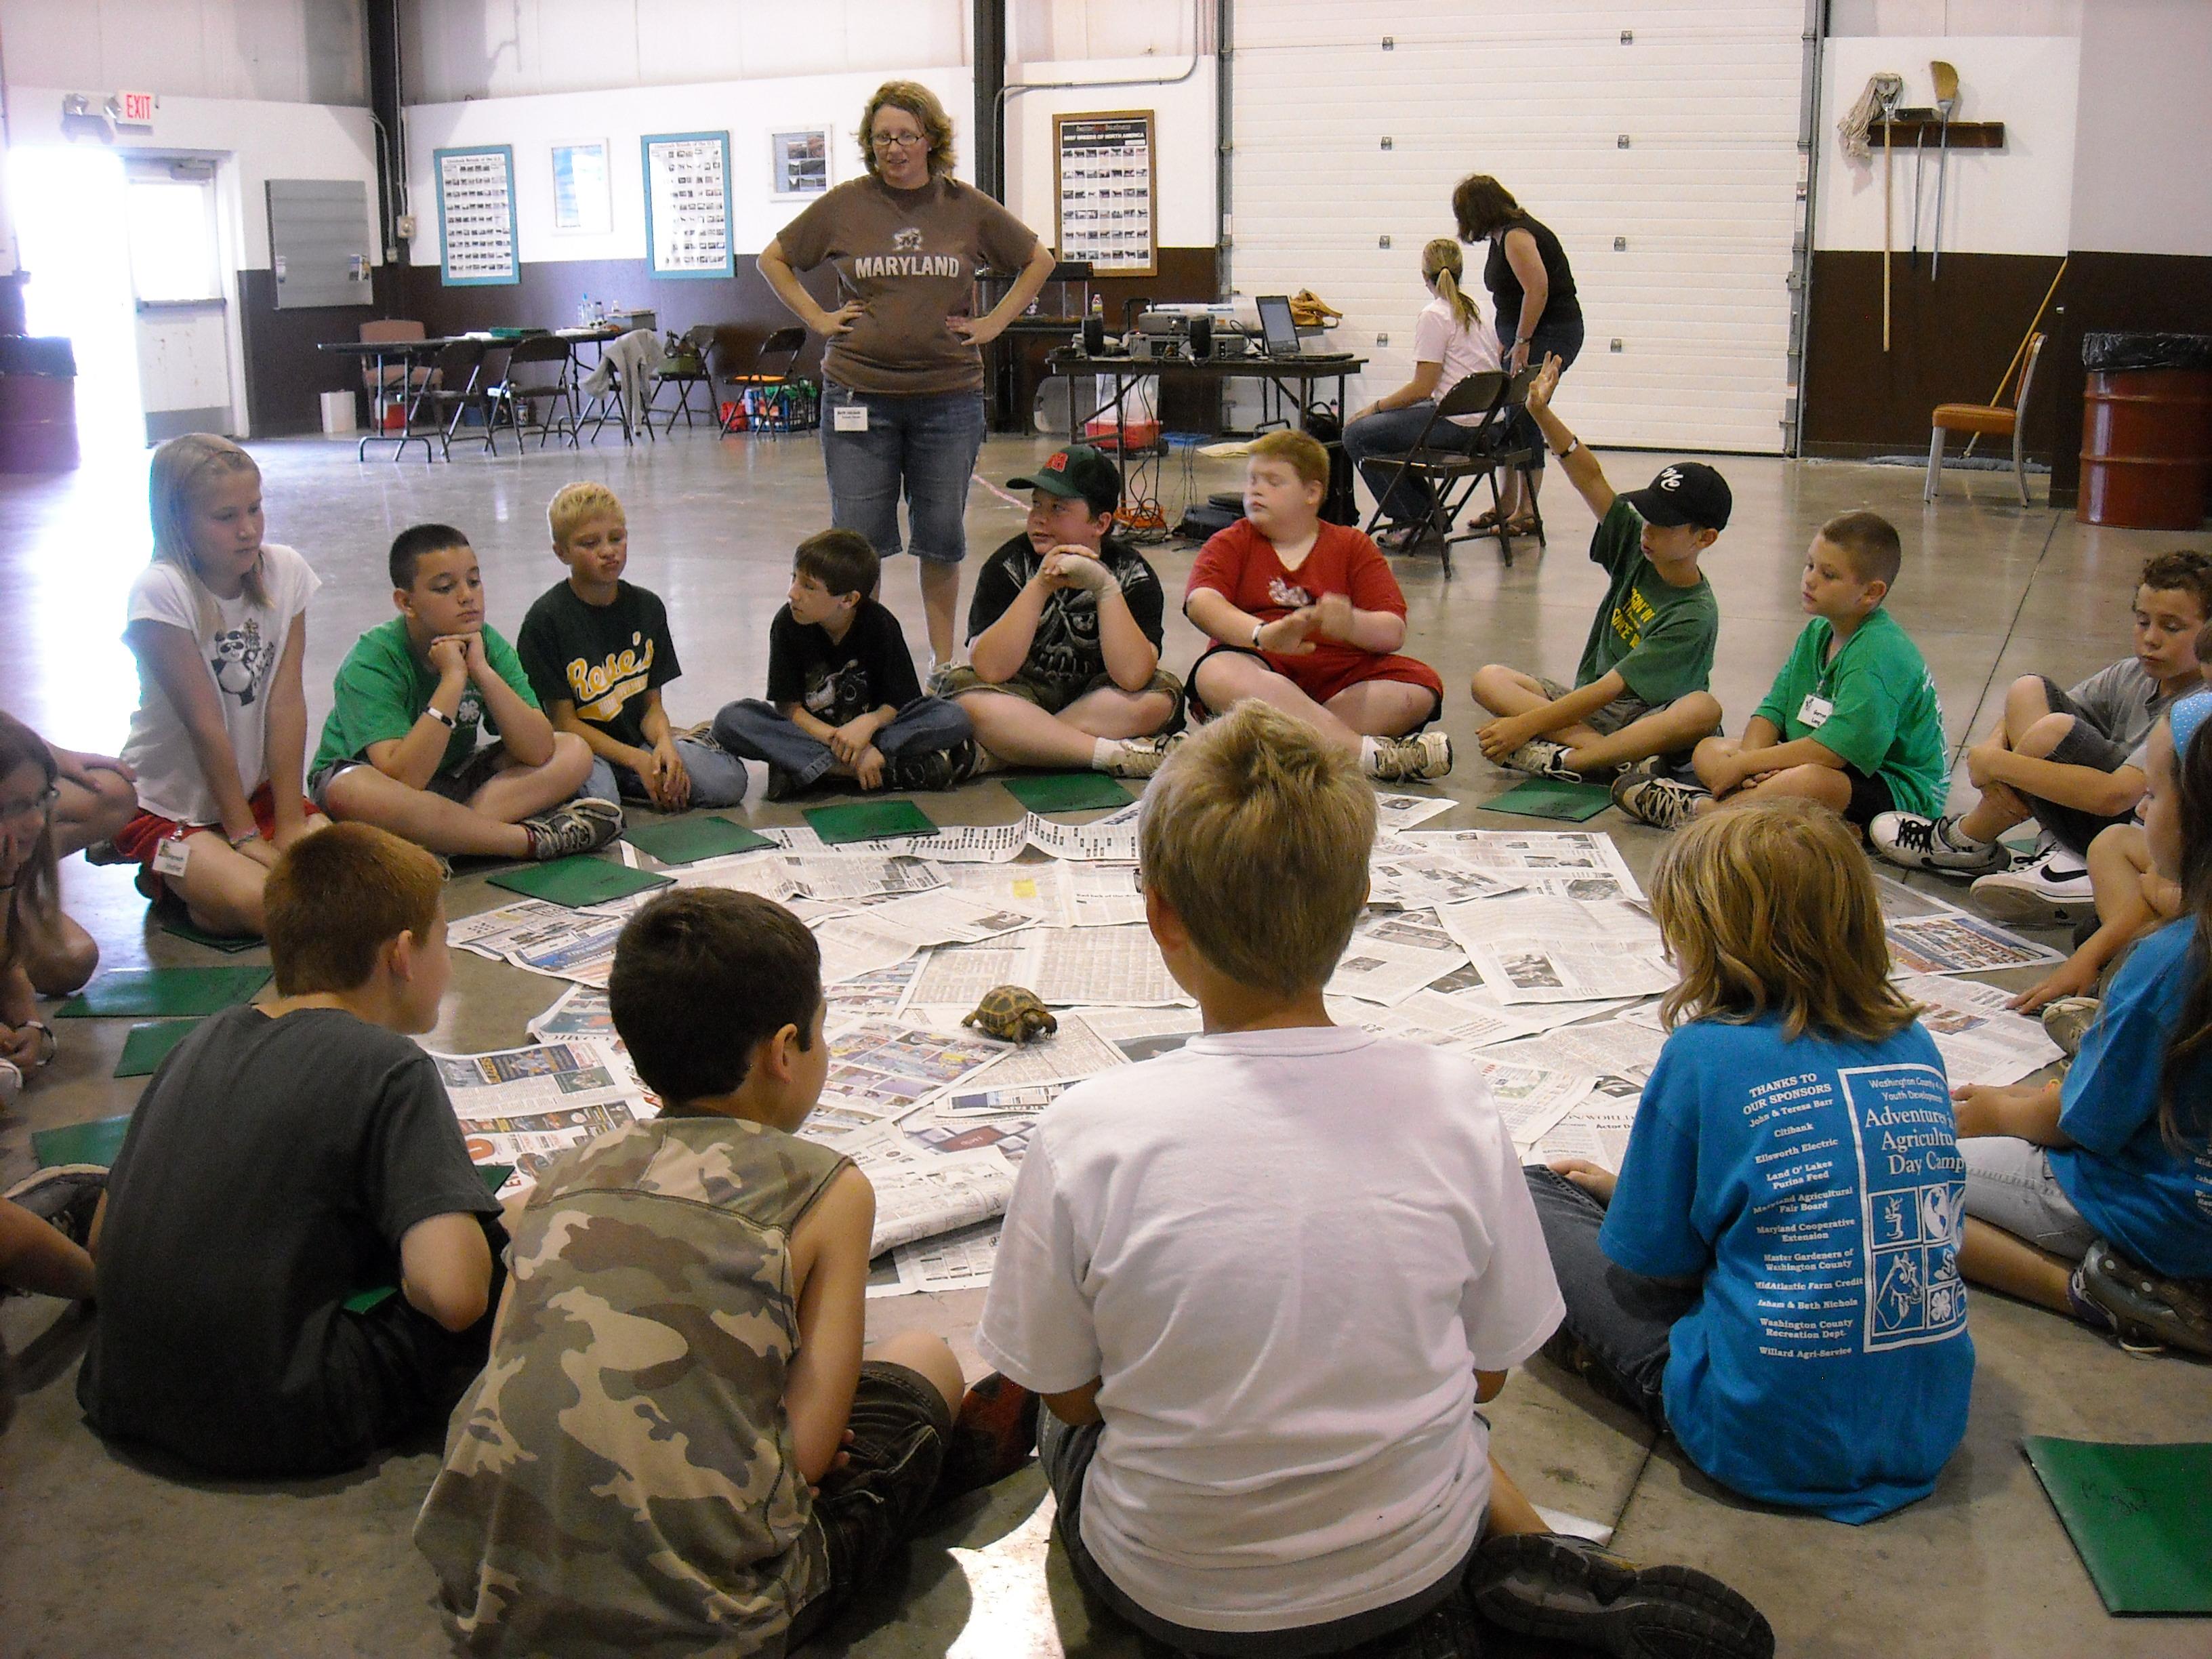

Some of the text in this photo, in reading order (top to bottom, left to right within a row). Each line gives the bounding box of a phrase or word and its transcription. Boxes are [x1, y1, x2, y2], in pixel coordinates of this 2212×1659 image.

[126, 94, 150, 119] EXIT
[855, 255, 960, 279] MARYLAND
[1612, 607, 1633, 640] SINCE
[1749, 1073, 1817, 1098] THANKS TO
[1868, 1078, 1915, 1090] Washington
[1743, 1084, 1832, 1115] OUR SPONSORS
[1881, 1090, 1908, 1101] Youth
[1749, 1099, 1833, 1128] John & Teresa Barr
[1774, 1122, 1814, 1137] Citibank
[1881, 1127, 1954, 1153] Agricultu
[1755, 1138, 1839, 1164] Ellsworth Electric
[1766, 1169, 1790, 1181] Land
[1805, 1161, 1833, 1172] Lakes
[1887, 1150, 1965, 1176] Day Camp
[1773, 1170, 1829, 1189] Purina Feed
[1798, 1186, 1853, 1203] Agricultural
[1778, 1201, 1828, 1214] Fair Board
[1756, 1218, 1856, 1234] Maryland Cooperative
[1782, 1231, 1829, 1243] Extension
[1764, 1248, 1855, 1262] Master Gardeners of
[1765, 1258, 1853, 1273] Washington County
[1835, 1277, 1864, 1288] Credit
[1786, 1300, 1795, 1309] &
[1797, 1301, 1821, 1310] Beth
[1759, 1317, 1853, 1331] Washington County
[1765, 1328, 1847, 1340] Recreation Dept.
[1759, 1346, 1853, 1359] Willard Agri-Service
